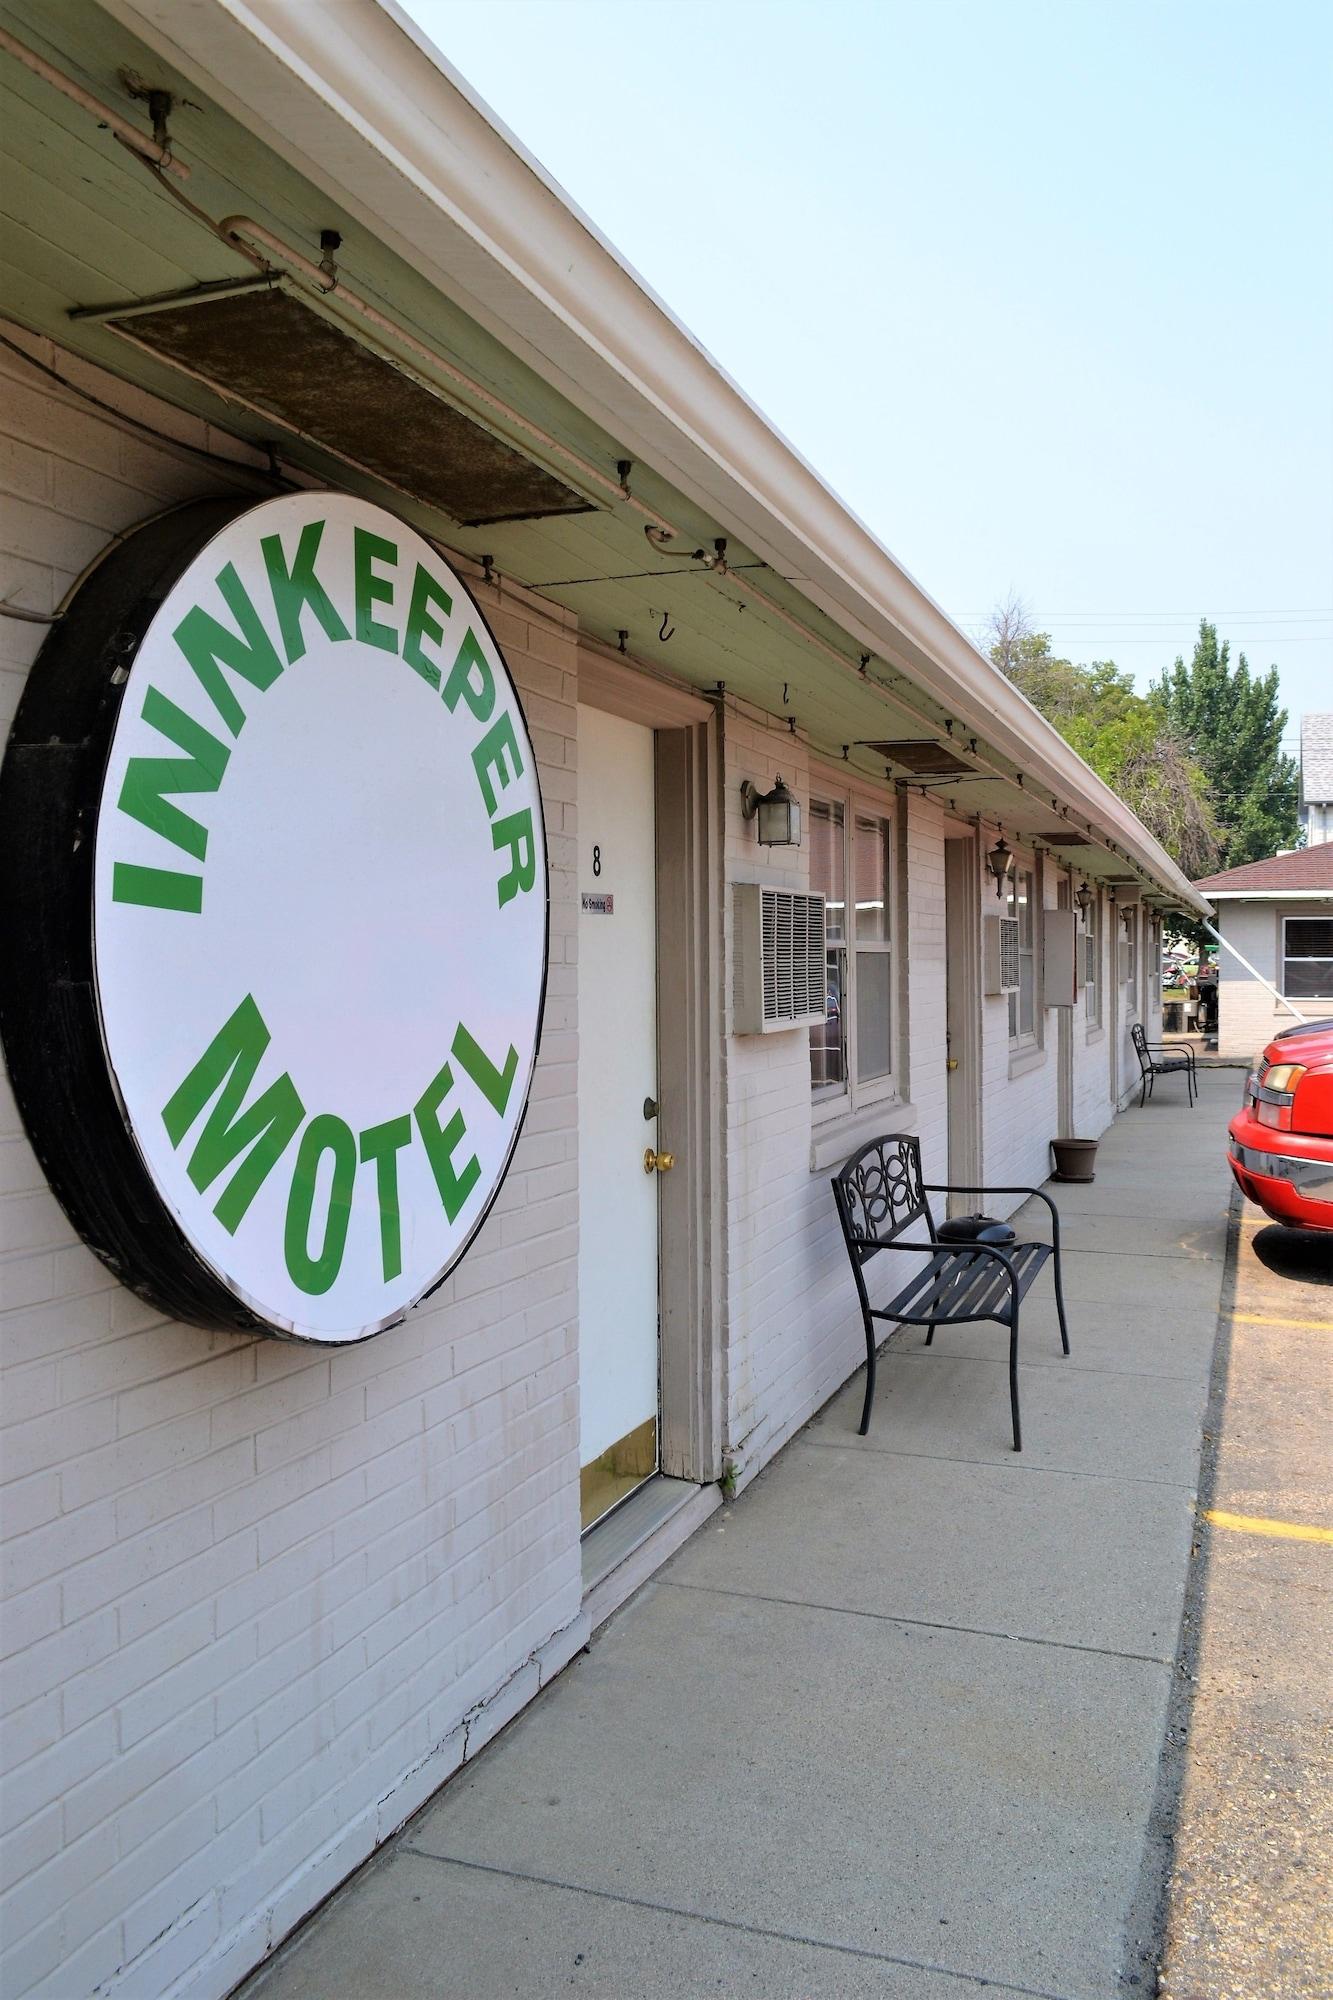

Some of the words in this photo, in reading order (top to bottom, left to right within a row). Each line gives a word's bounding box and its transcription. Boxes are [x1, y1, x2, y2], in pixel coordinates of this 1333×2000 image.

[113, 520, 536, 914] INNKEEPER
[582, 898, 588, 910] No
[588, 898, 606, 912] Smoking
[593, 845, 601, 877] 8
[162, 993, 519, 1296] MOTEL
